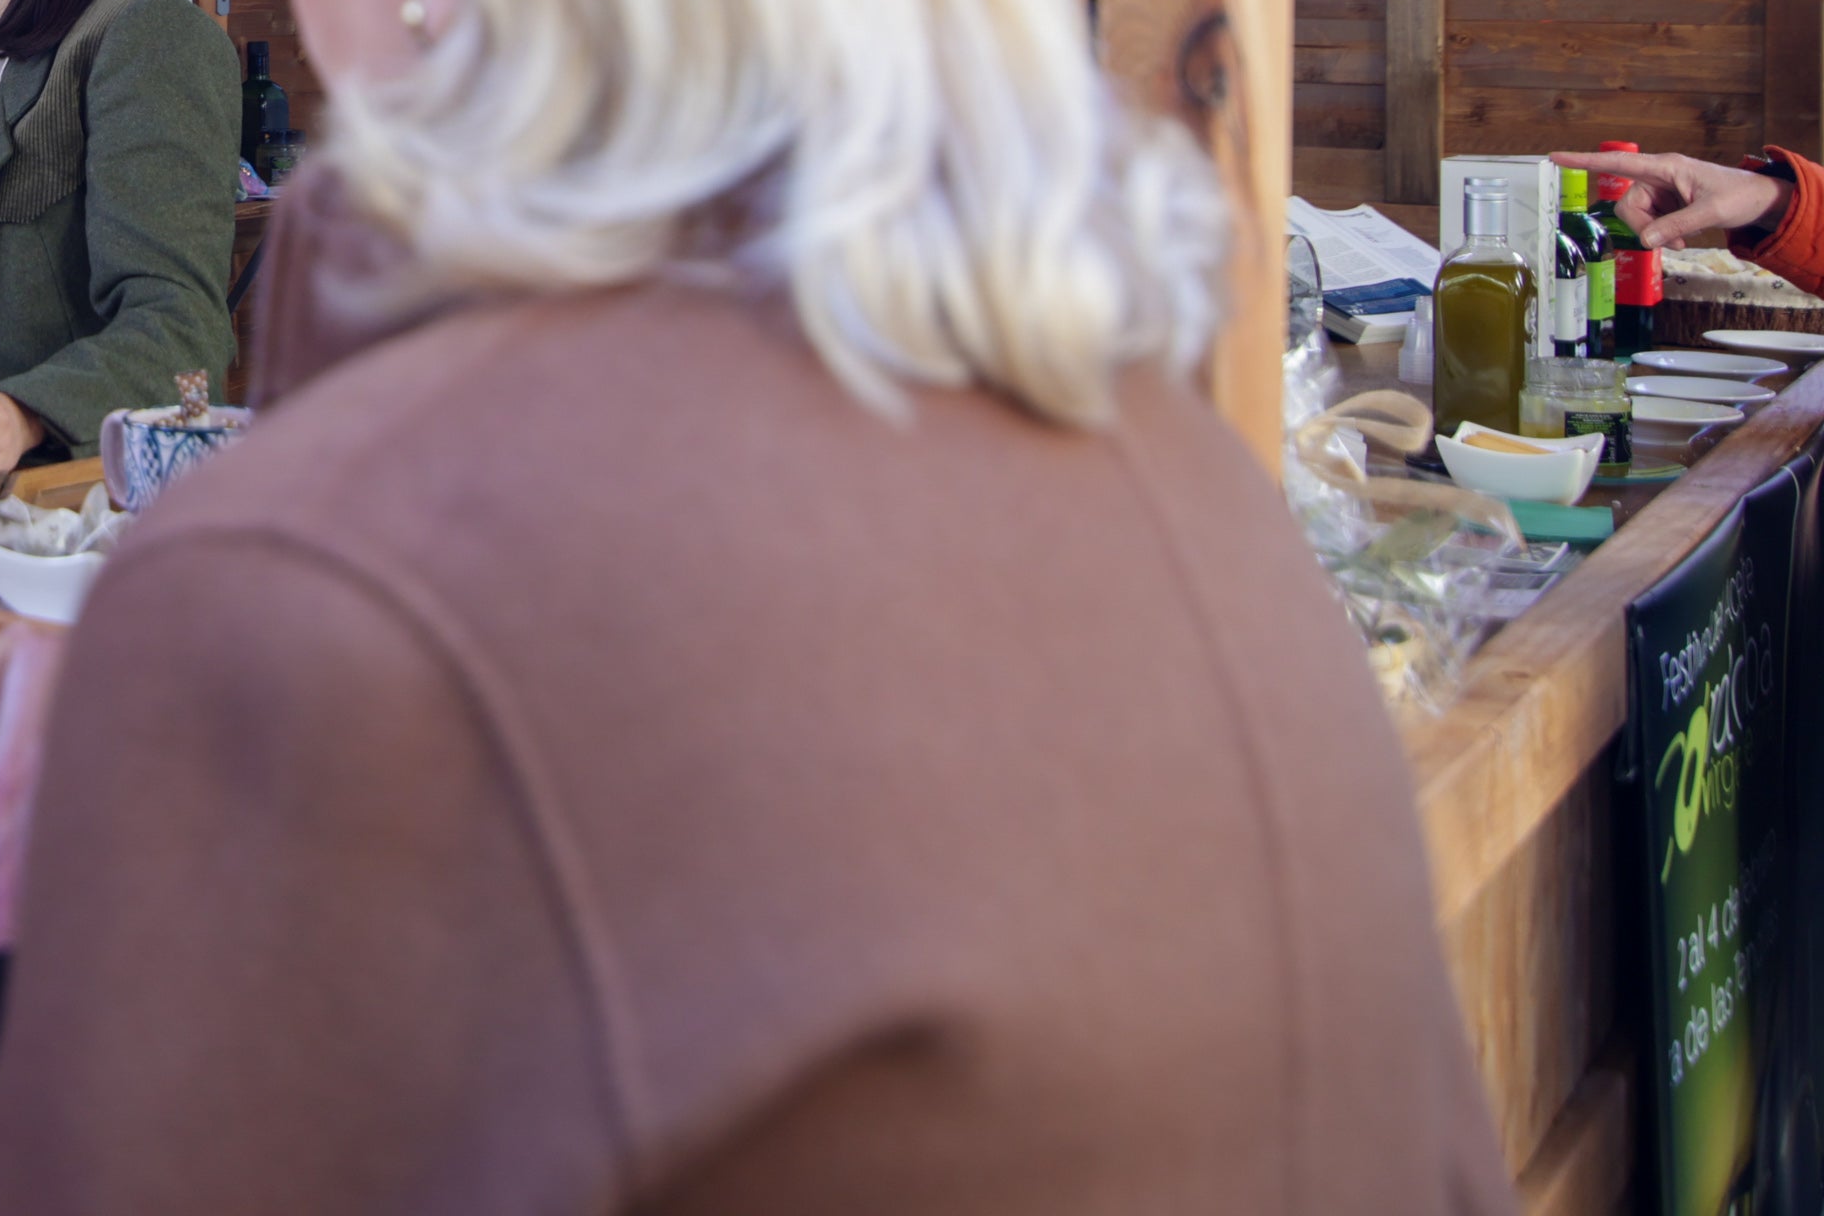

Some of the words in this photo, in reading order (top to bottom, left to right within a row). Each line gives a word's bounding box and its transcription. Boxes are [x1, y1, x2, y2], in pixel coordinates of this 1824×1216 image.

[1677, 937, 1688, 994] 2
[1689, 913, 1706, 977] al
[1708, 902, 1720, 951] 4
[1684, 1004, 1709, 1066] de
[1710, 981, 1734, 1035] las
